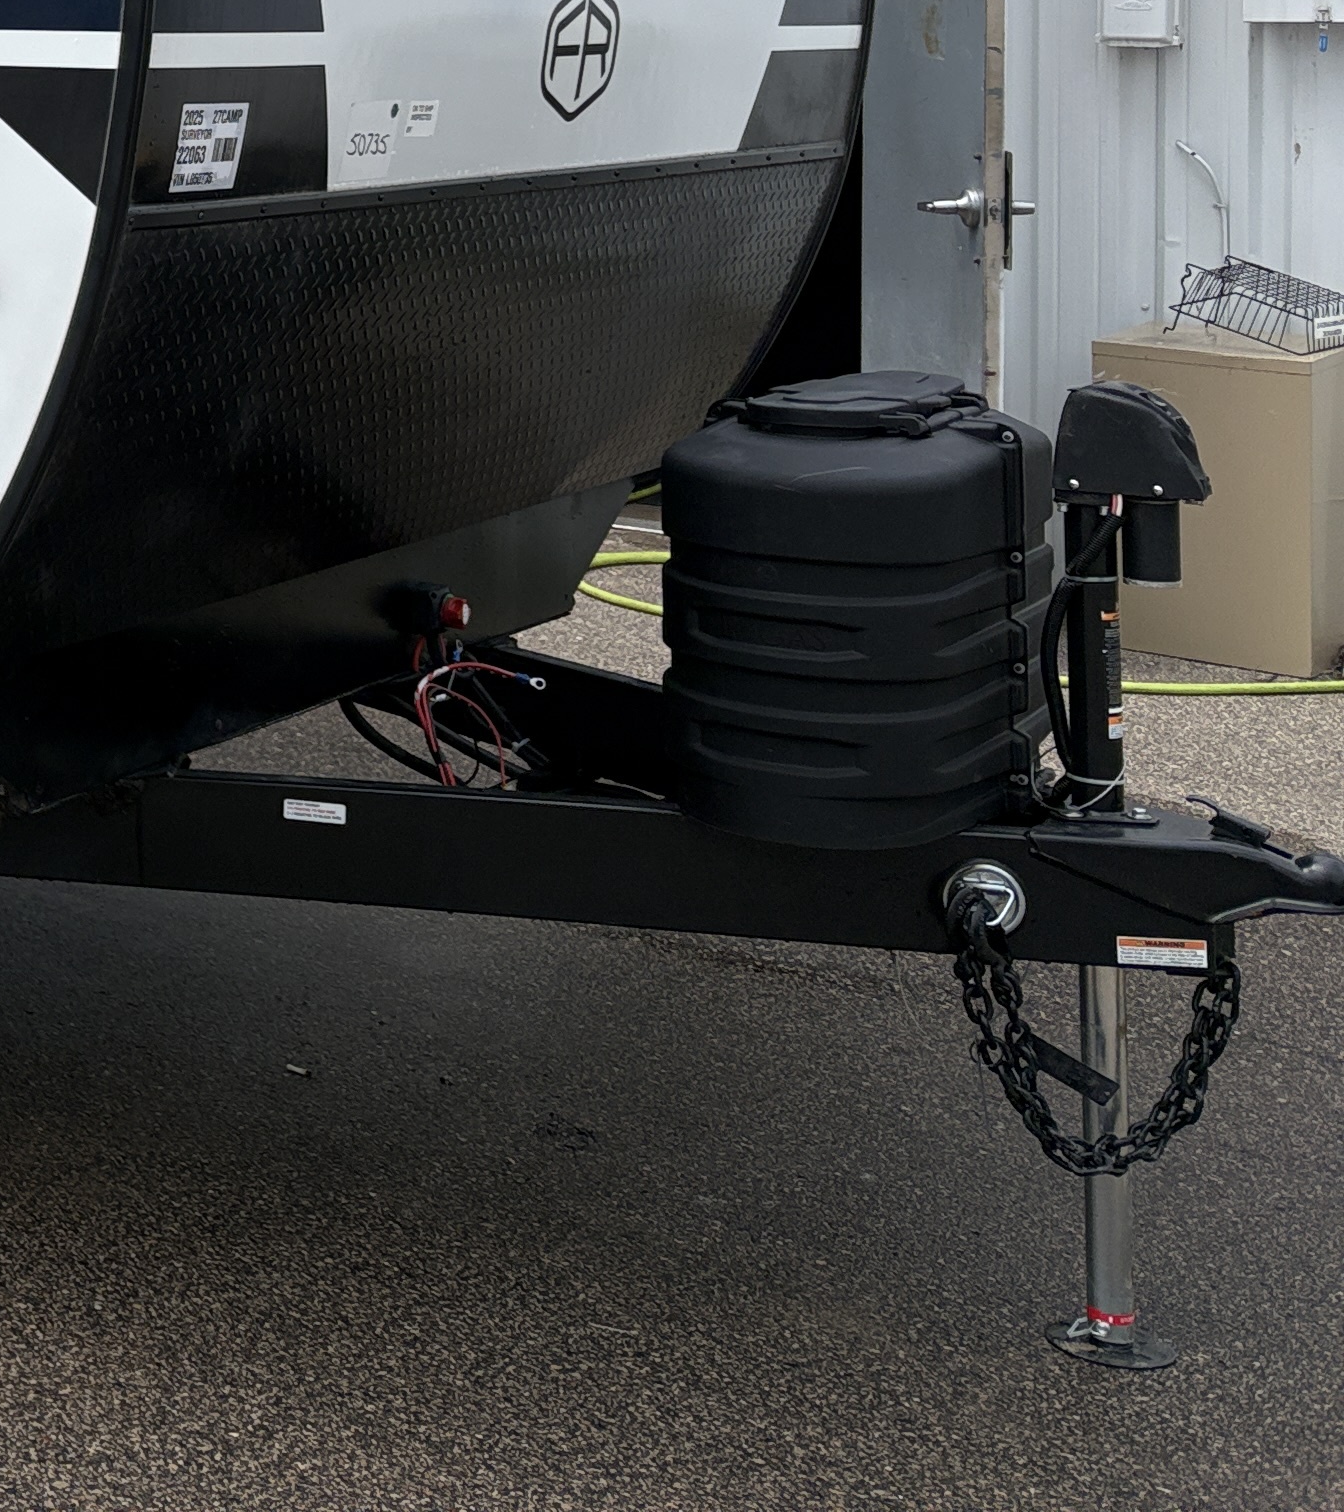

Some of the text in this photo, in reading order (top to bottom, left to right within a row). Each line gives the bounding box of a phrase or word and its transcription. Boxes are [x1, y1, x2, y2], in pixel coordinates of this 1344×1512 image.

[183, 109, 243, 126] 2025 27CAMP
[345, 132, 391, 157] 50735
[176, 145, 207, 165] 22063
[1144, 940, 1185, 948] WARNING
